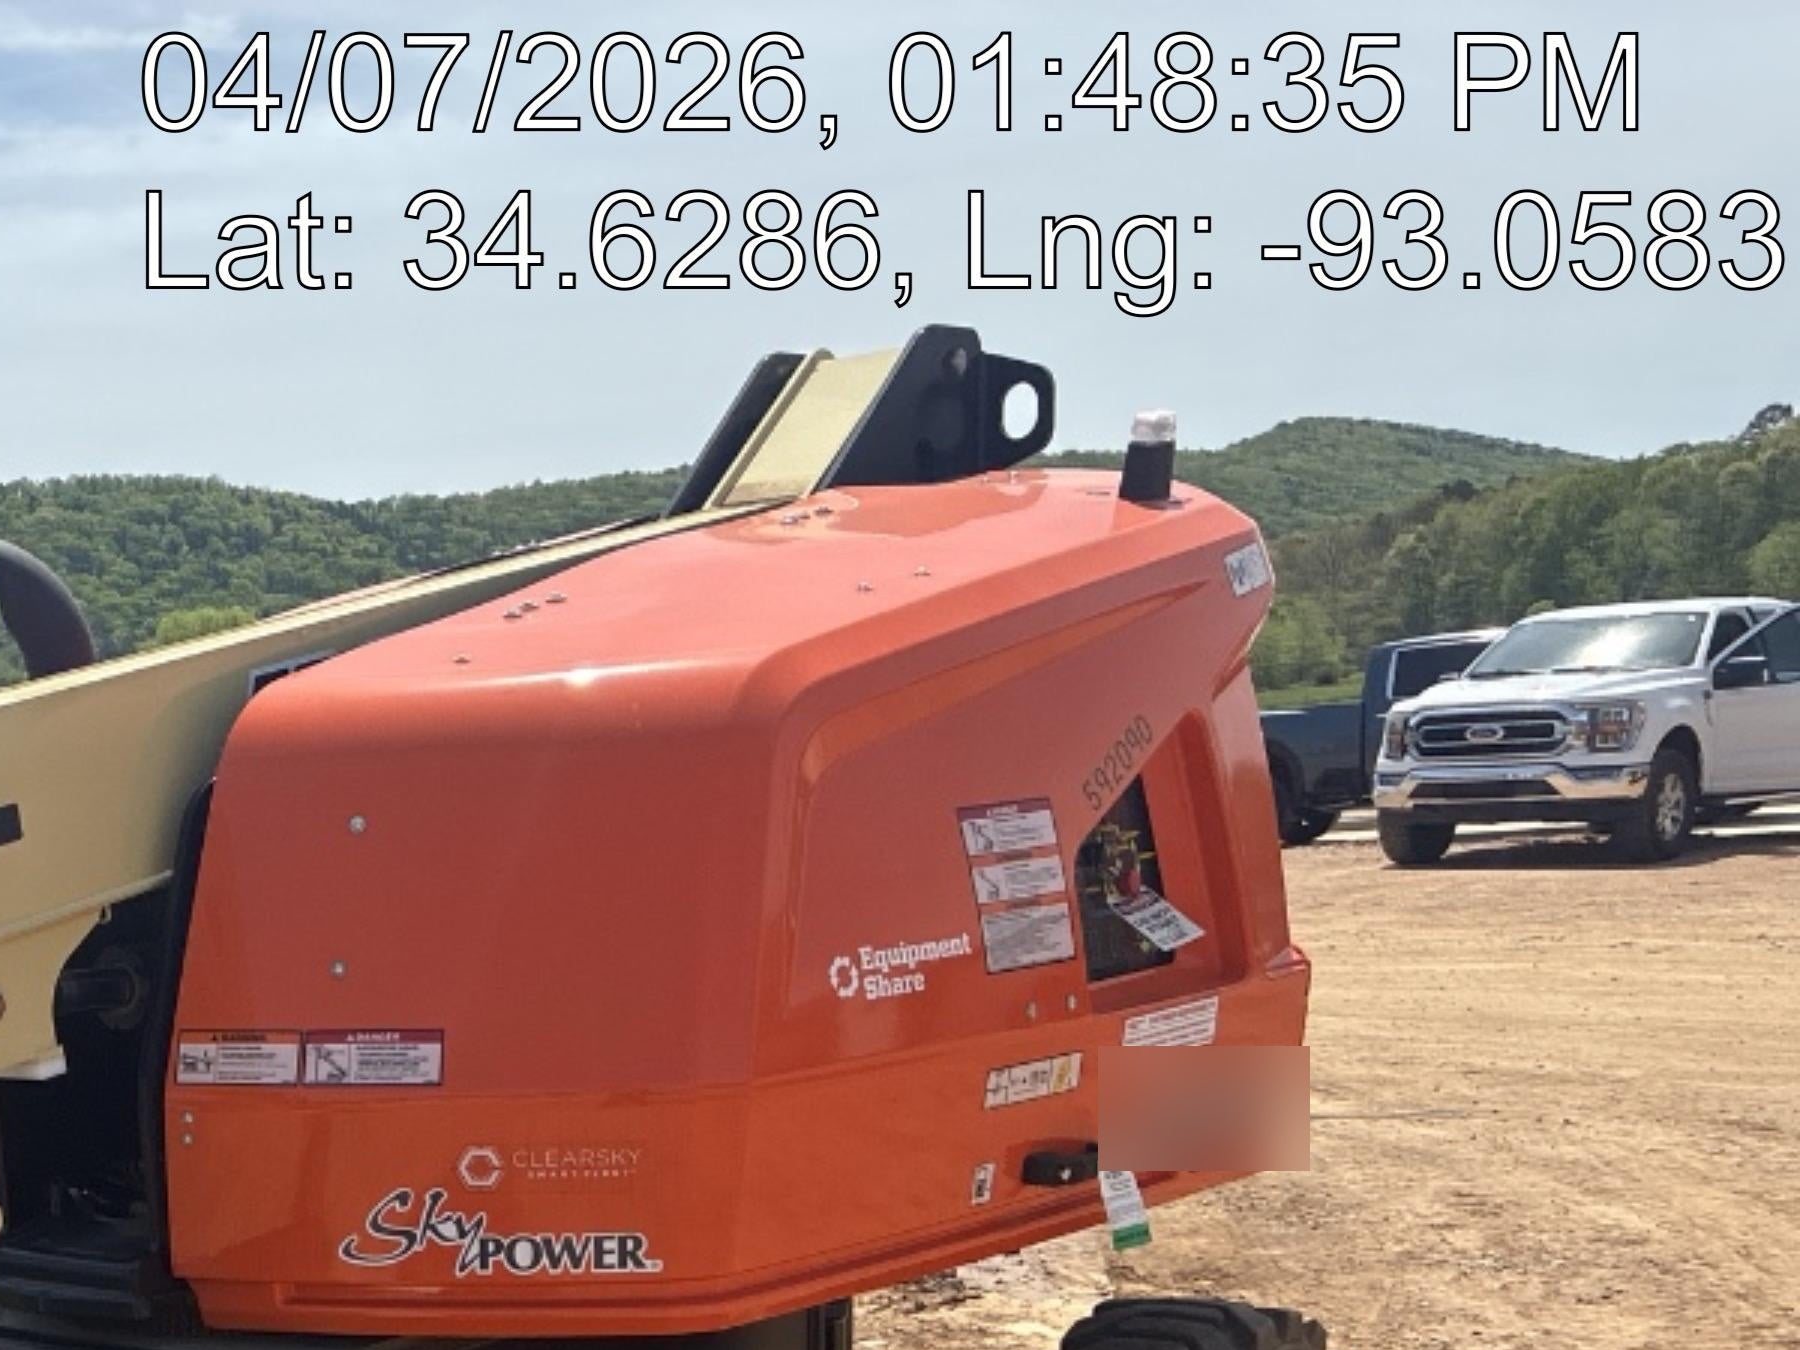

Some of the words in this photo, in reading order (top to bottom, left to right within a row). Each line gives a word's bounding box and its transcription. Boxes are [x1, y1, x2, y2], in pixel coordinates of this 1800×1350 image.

[1081, 713, 1153, 811] 592090
[856, 932, 973, 973] Equipment
[863, 972, 926, 1000] Share
[511, 1148, 642, 1169] CLEARSKY
